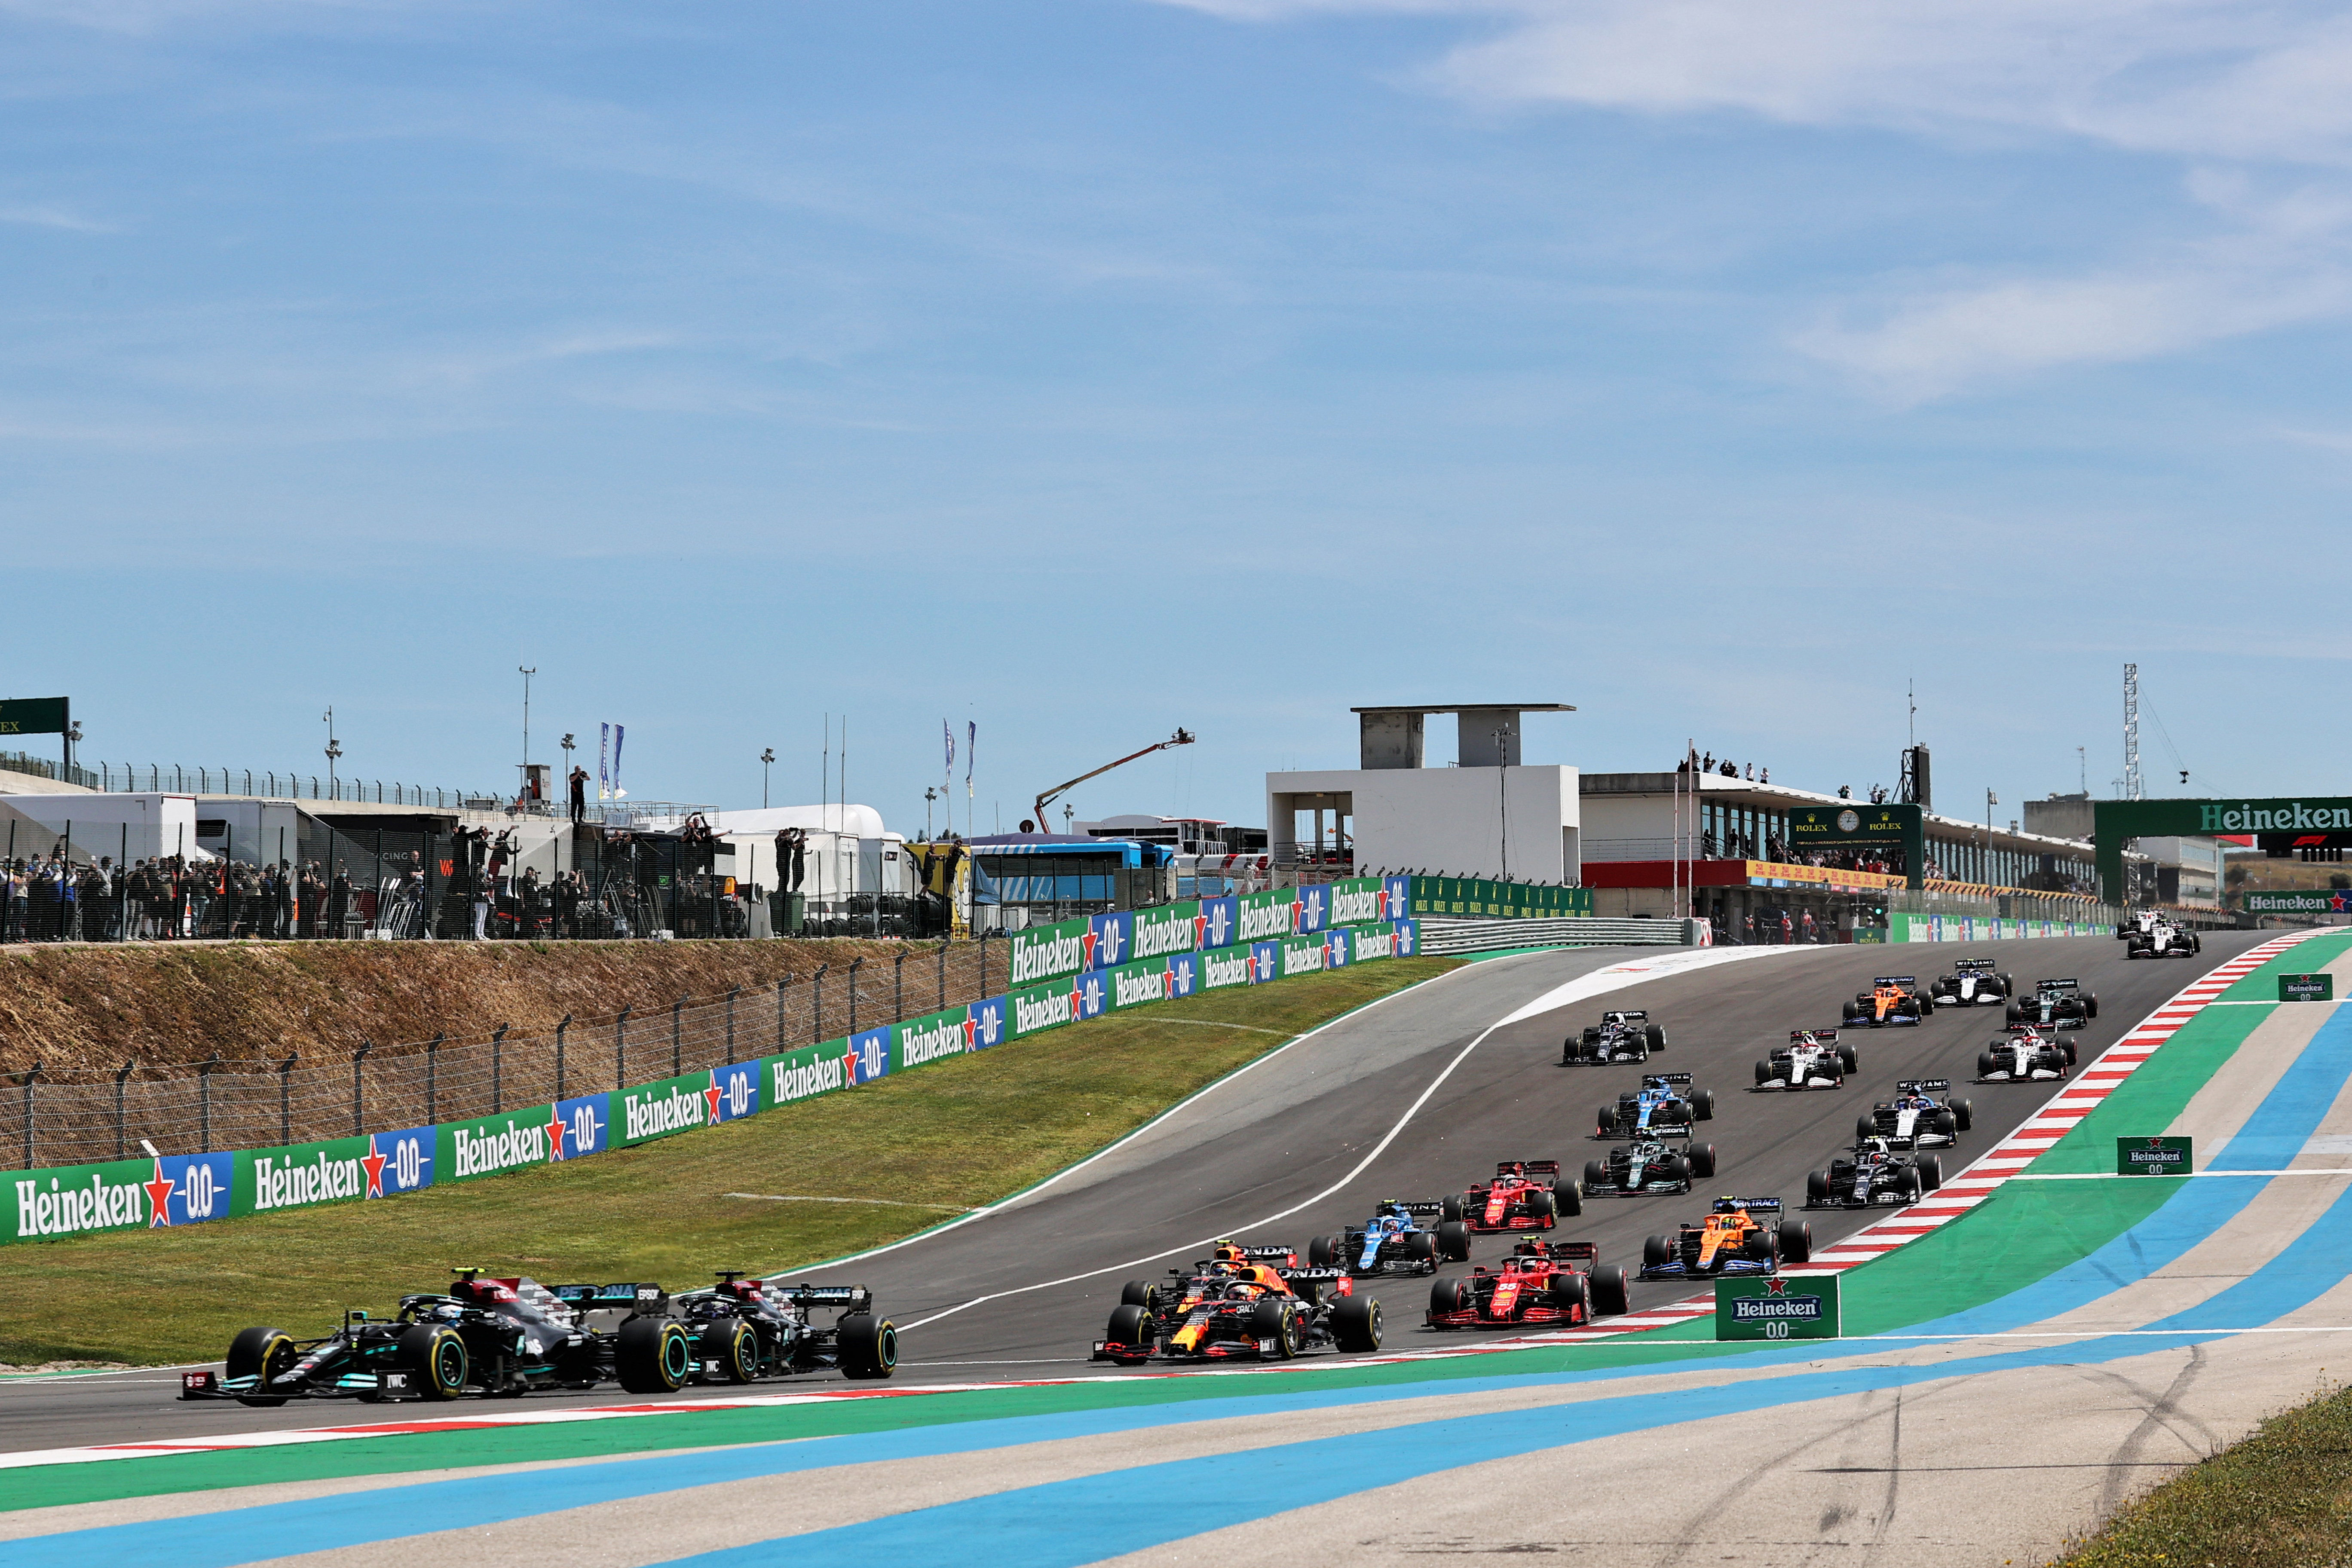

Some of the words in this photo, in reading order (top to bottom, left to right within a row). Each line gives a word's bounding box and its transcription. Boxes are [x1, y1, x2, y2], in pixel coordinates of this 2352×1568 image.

[0, 721, 20, 732] EX
[2200, 803, 2352, 830] Heineken
[1239, 896, 1289, 940] Heineken
[1307, 889, 1320, 930] 0.0
[1331, 883, 1375, 924] Heineken
[1392, 881, 1402, 919] 0.0
[1415, 900, 1428, 911] ROLEX
[1433, 900, 1446, 912] ROLEX
[1452, 902, 1464, 913] ROLEX
[2249, 895, 2326, 910] Heineken
[1133, 910, 1191, 959] Heineken
[1212, 903, 1225, 946] 0.0
[1355, 930, 1390, 961] Heineken
[1402, 925, 1410, 954] 0.0
[1012, 929, 1079, 983] Heineken
[1103, 919, 1118, 964] 0.0
[1205, 952, 1246, 988] Heineken
[1260, 947, 1271, 980] 0.0
[1283, 941, 1322, 975] Heineken
[1335, 935, 1344, 965] 0.0
[1115, 967, 1162, 1007] Heineken
[1179, 960, 1189, 994] 0.0
[1016, 990, 1069, 1034] Heineken
[1086, 978, 1099, 1015] 0.0
[902, 1019, 962, 1067] Heineken
[983, 1005, 997, 1045] 0.0
[773, 1053, 842, 1104] Heineken
[864, 1036, 881, 1079] 0.0
[625, 1086, 704, 1140] Heineken
[730, 1072, 748, 1116] 0.0
[453, 1120, 545, 1177] Heineken
[574, 1105, 595, 1152] 0.0
[2131, 1152, 2180, 1161] Heineken
[255, 1152, 360, 1210] Heineken
[396, 1138, 419, 1188] 0.0
[15, 1174, 142, 1236] Heineken
[186, 1164, 212, 1219] 0.0
[1241, 1246, 1288, 1255] ONDA
[1278, 1268, 1339, 1278] ONDA
[1736, 1301, 1816, 1317] Heineken
[1766, 1321, 1788, 1339] 0.0
[387, 1374, 407, 1388] IWC
[706, 1360, 720, 1372] IWC
